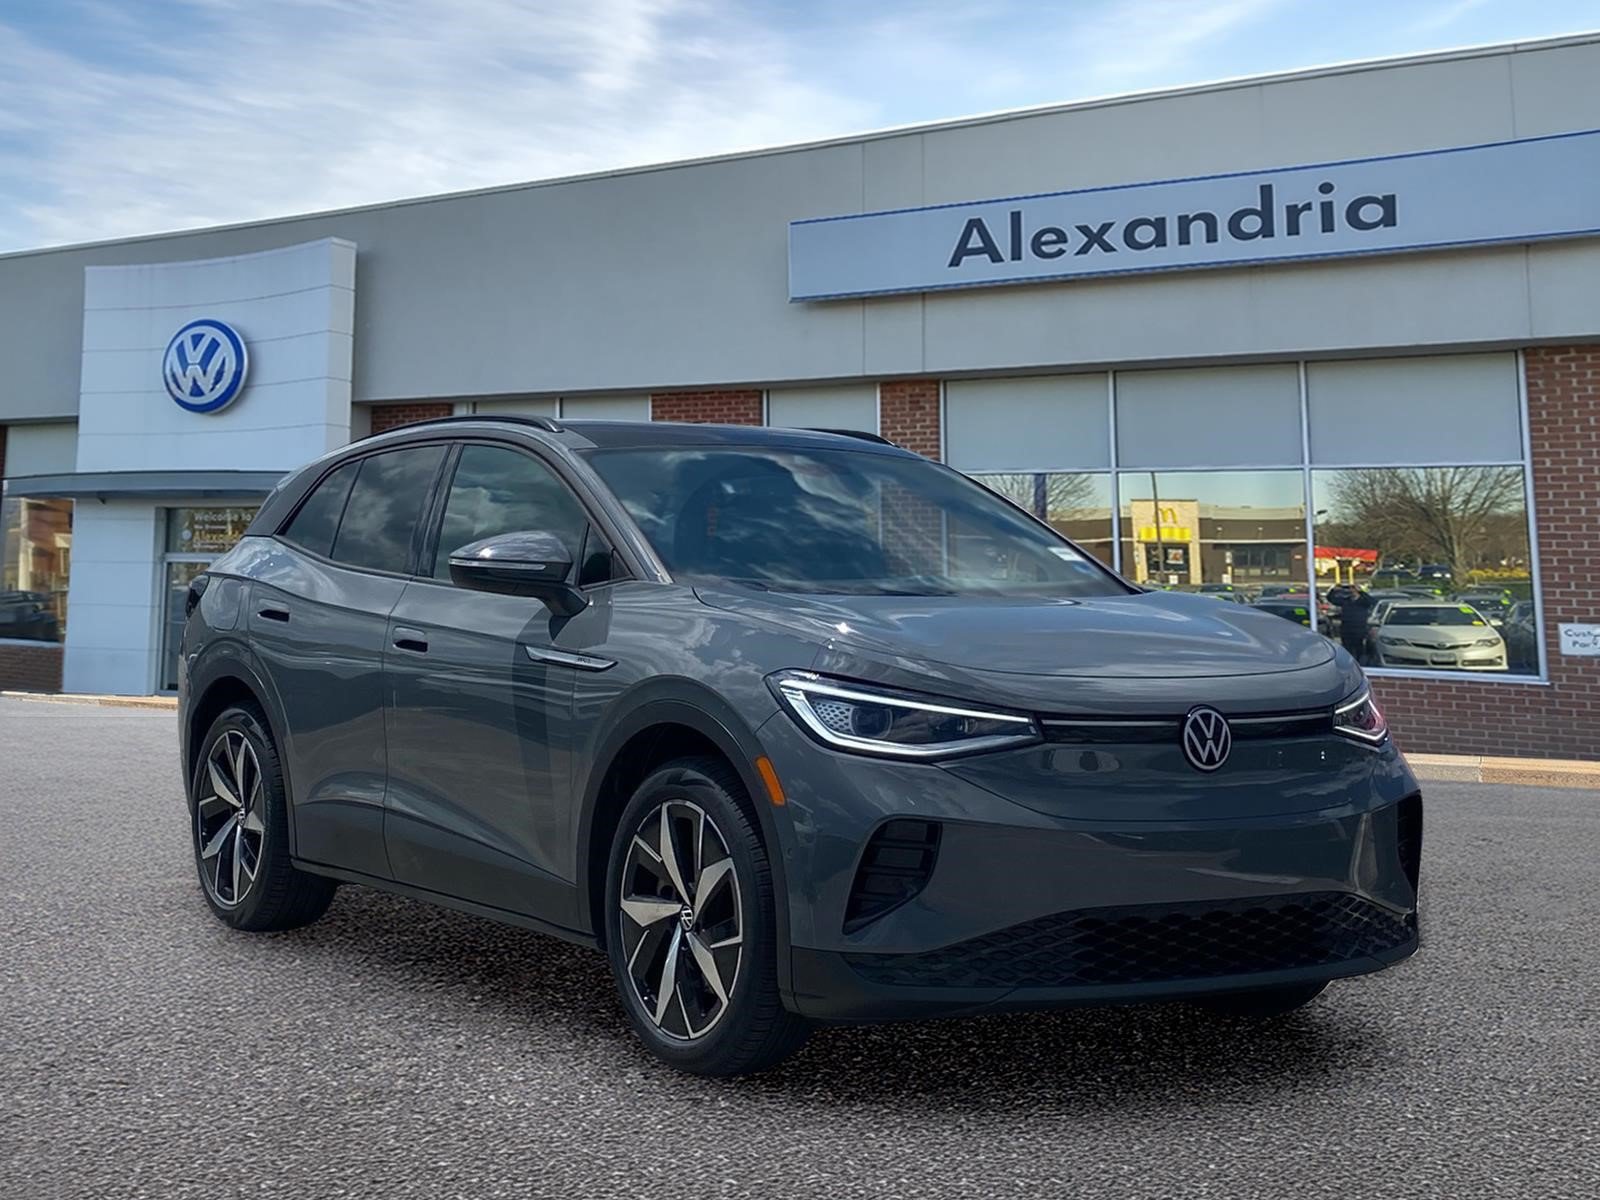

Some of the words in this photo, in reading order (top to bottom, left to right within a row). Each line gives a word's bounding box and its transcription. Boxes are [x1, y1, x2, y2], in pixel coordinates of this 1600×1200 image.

[948, 181, 1398, 268] Alexandria
[165, 325, 237, 405] VW
[193, 512, 239, 522] Welcome
[1184, 709, 1231, 770] VW
